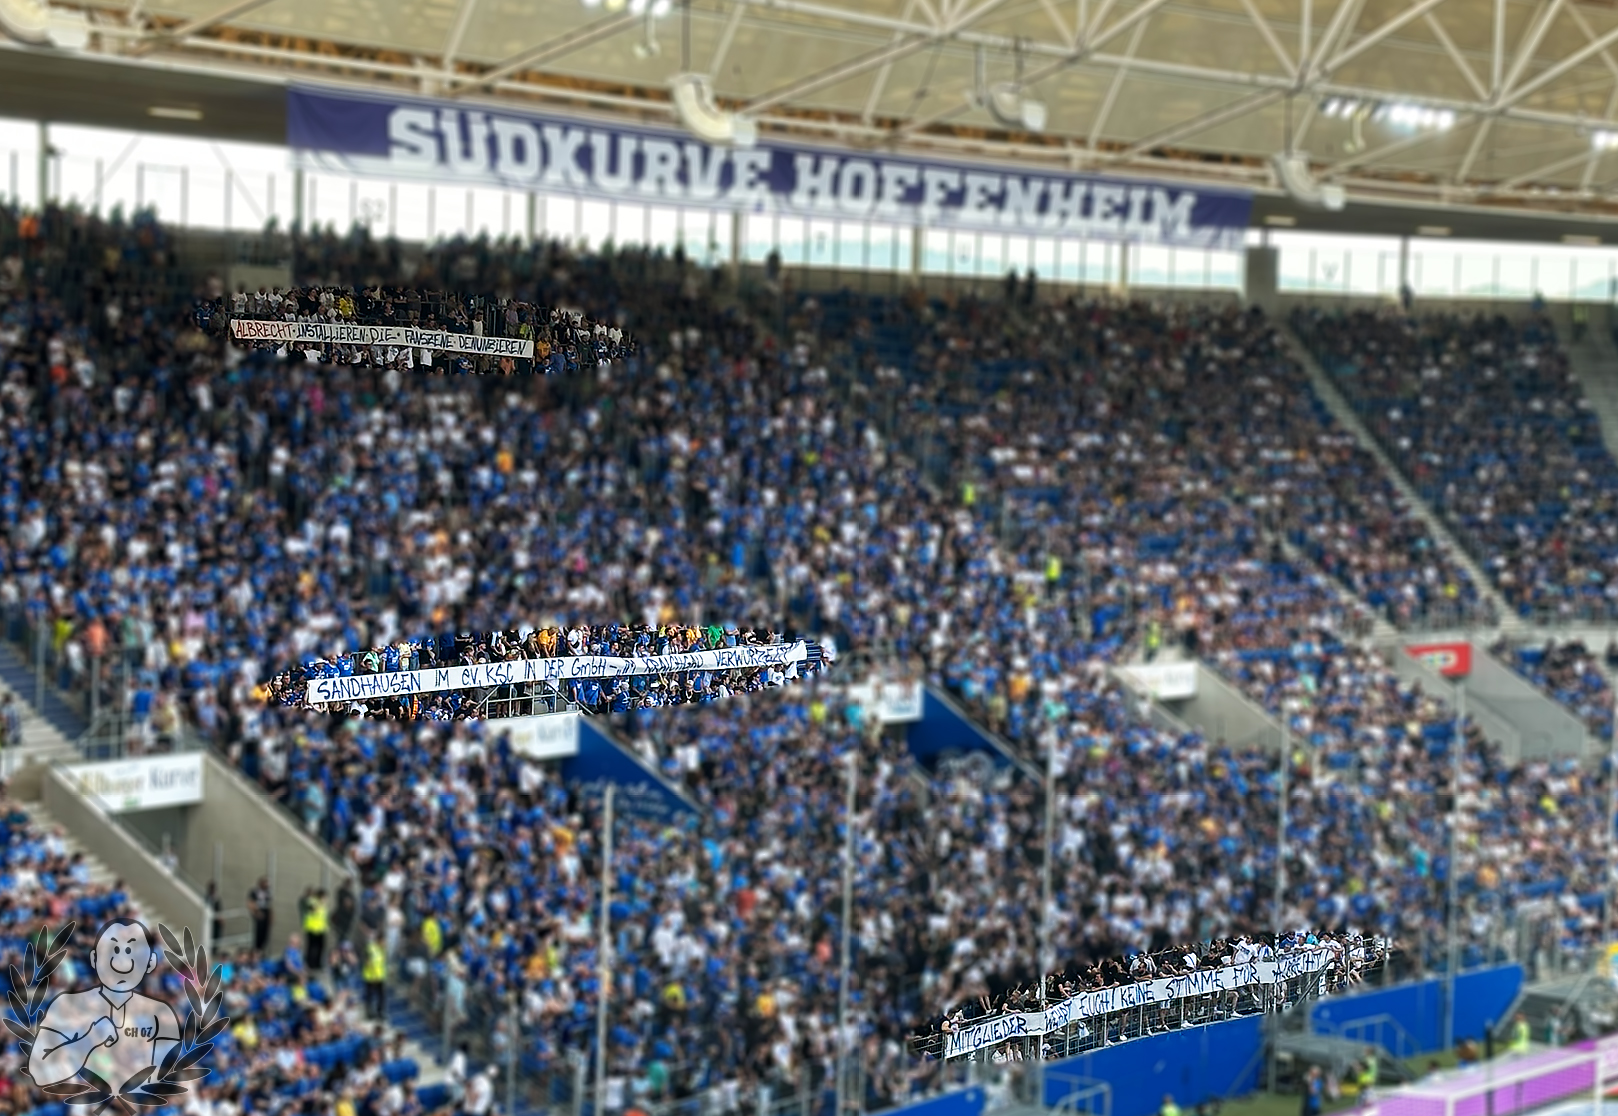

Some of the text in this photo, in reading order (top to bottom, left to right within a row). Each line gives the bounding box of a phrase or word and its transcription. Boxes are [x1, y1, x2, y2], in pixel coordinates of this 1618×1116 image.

[388, 106, 1197, 236] SÜDKURVE HOFFENHEIM
[236, 320, 293, 338] ALBRECHT
[405, 330, 454, 348] FANSZENE
[317, 672, 421, 700] SANDHAUSEN
[435, 670, 450, 687] IM
[486, 663, 514, 684] KSC
[524, 660, 536, 680] IN
[544, 659, 565, 679] DER
[571, 657, 606, 676] GmbH
[642, 654, 704, 674] KRAICHGAU
[951, 1016, 1028, 1054] MITGLIEDER
[1079, 988, 1116, 1016] EUCH!
[1120, 981, 1155, 1006] KEINE
[1166, 970, 1224, 999] STIMME
